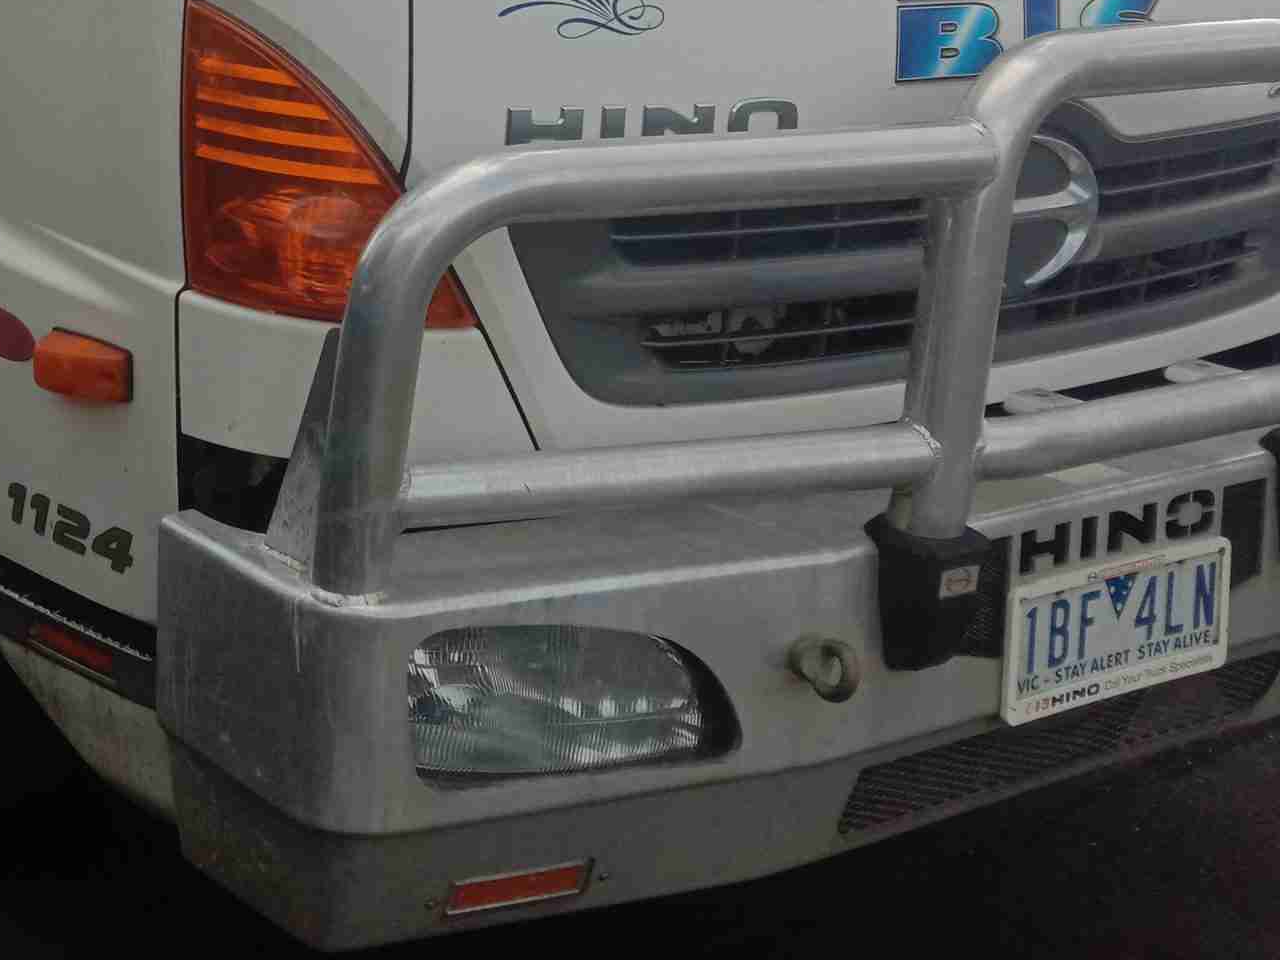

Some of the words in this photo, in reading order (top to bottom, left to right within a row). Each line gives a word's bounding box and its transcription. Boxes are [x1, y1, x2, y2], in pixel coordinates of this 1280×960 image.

[504, 97, 799, 146] HINO
[7, 482, 134, 573] 1124
[1020, 488, 1217, 576] HINO
[1025, 590, 1103, 674] 1BF
[1134, 561, 1217, 641] 4LN
[1016, 675, 1040, 696] VIC
[1055, 663, 1087, 683] STAY
[1090, 649, 1131, 674] ALERT
[1137, 641, 1170, 660] STAY
[1173, 630, 1212, 649] ALIVE
[1052, 682, 1102, 708] HINO
